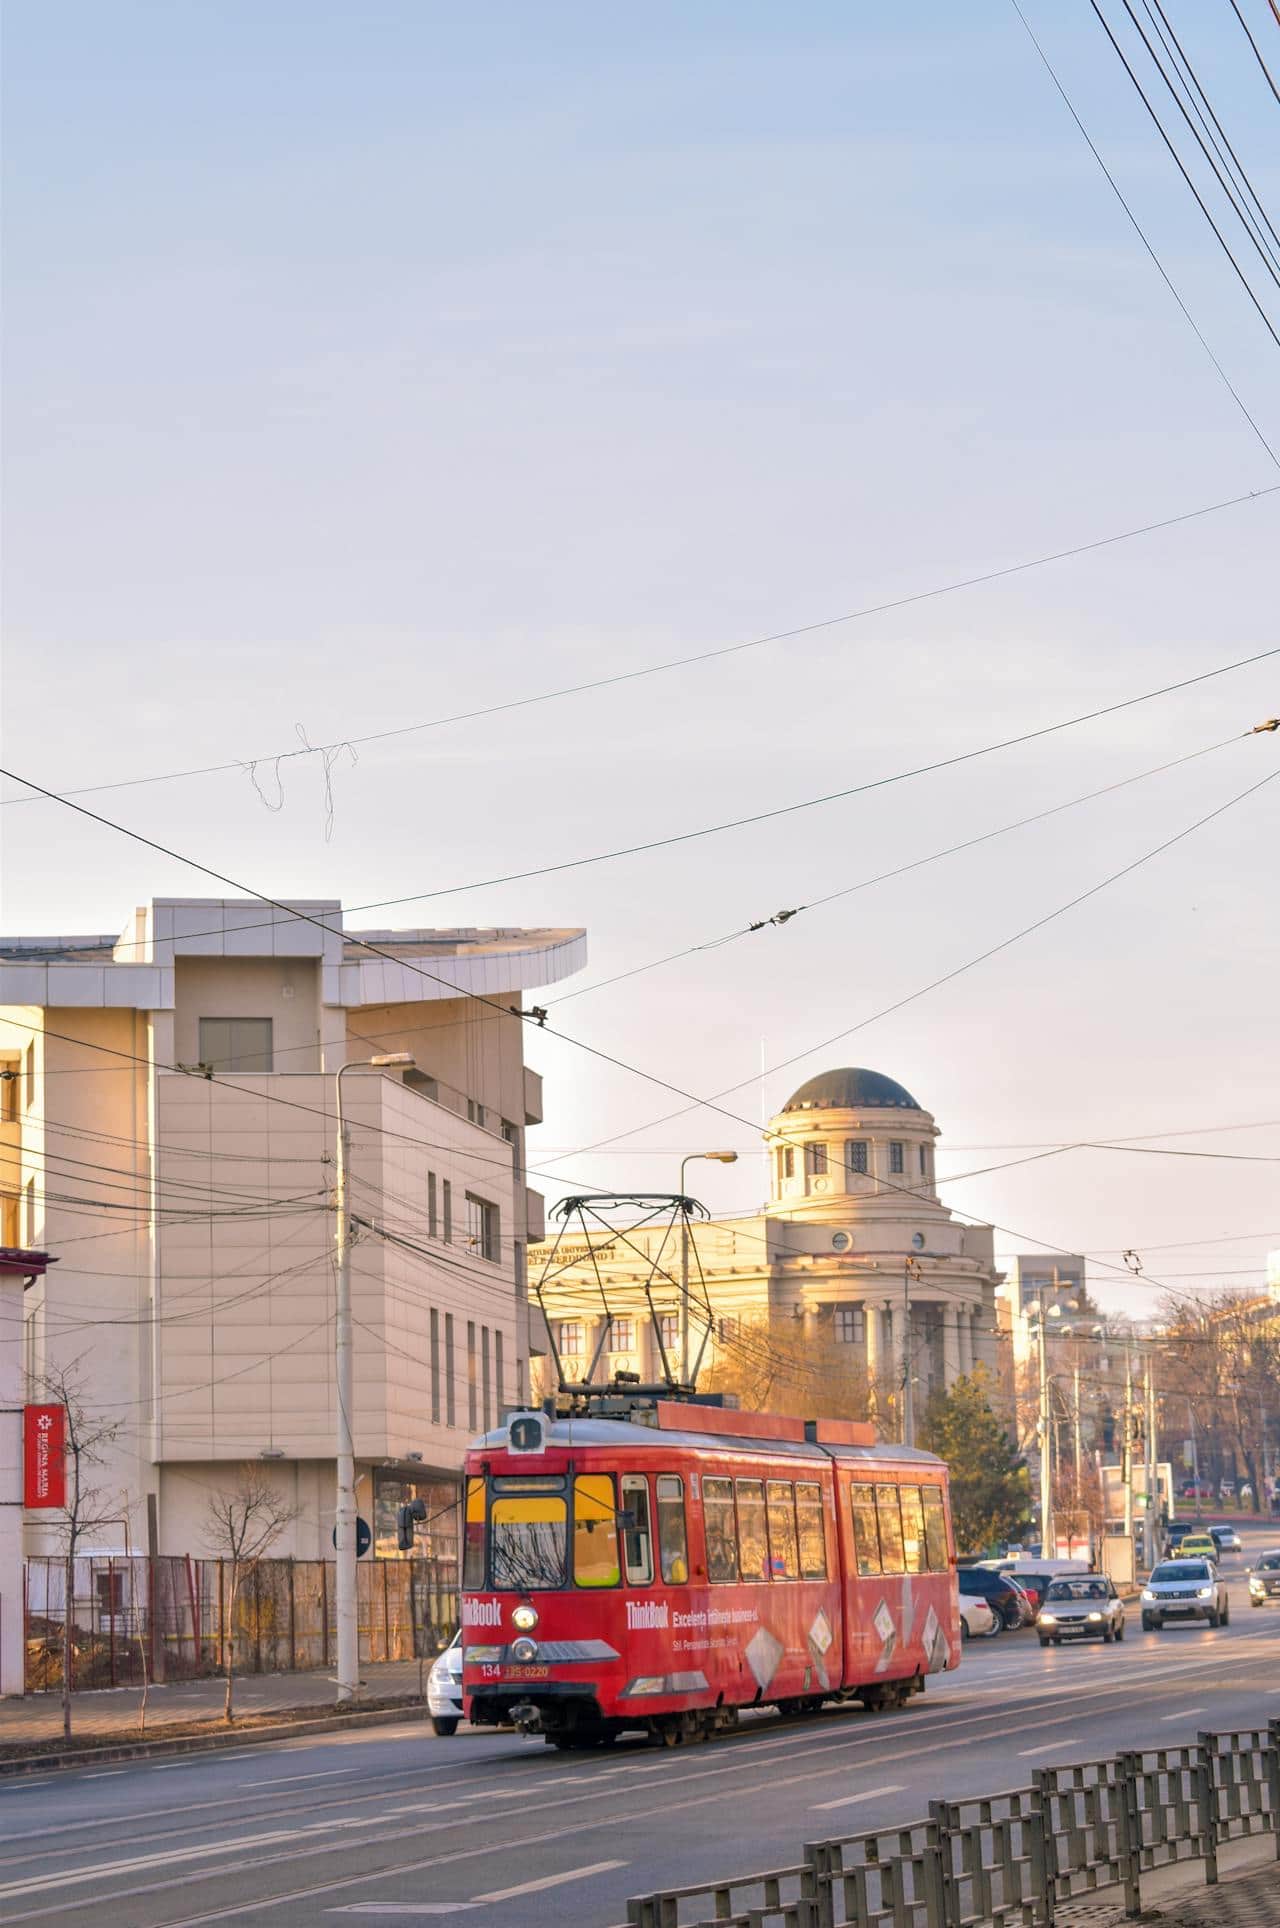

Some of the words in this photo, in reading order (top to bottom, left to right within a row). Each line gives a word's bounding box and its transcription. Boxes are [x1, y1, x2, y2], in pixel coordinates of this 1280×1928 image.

[41, 1432, 49, 1466] REGINA
[515, 1423, 526, 1447] 1
[41, 1468, 49, 1497] MARIA
[625, 1600, 669, 1630] ThinkBook
[481, 1664, 501, 1677] 134
